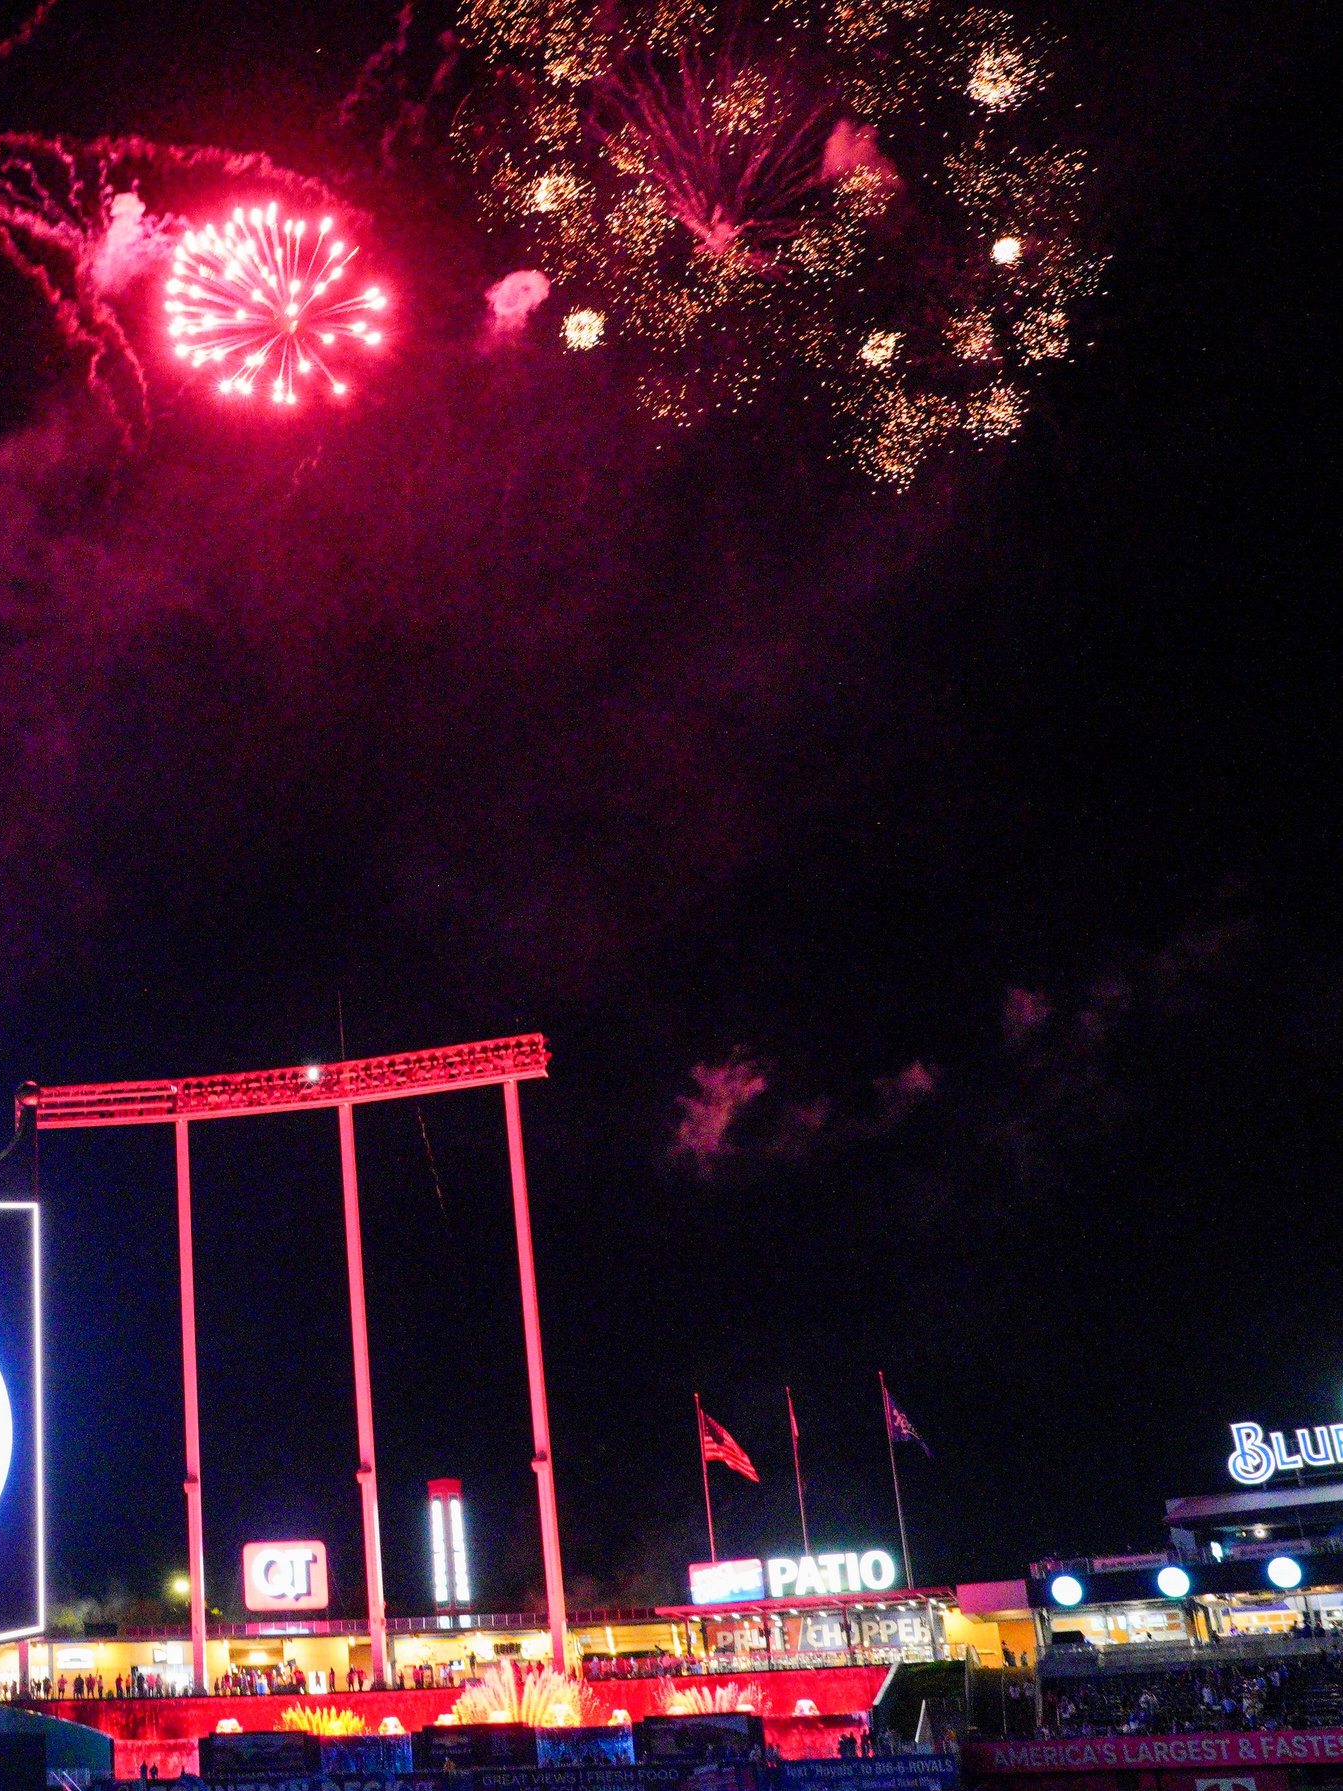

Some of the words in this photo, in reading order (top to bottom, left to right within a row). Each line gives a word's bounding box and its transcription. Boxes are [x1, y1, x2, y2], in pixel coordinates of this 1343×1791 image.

[251, 1548, 316, 1601] QT
[768, 1550, 895, 1597] PATIO
[993, 1743, 1118, 1768] AMERICA'S
[1123, 1738, 1230, 1764] LARGEST
[1238, 1737, 1257, 1760] &
[482, 1773, 528, 1786] GREAT
[531, 1772, 577, 1784] VIEWS
[586, 1770, 634, 1783] FRESH
[637, 1769, 679, 1781] FOOD
